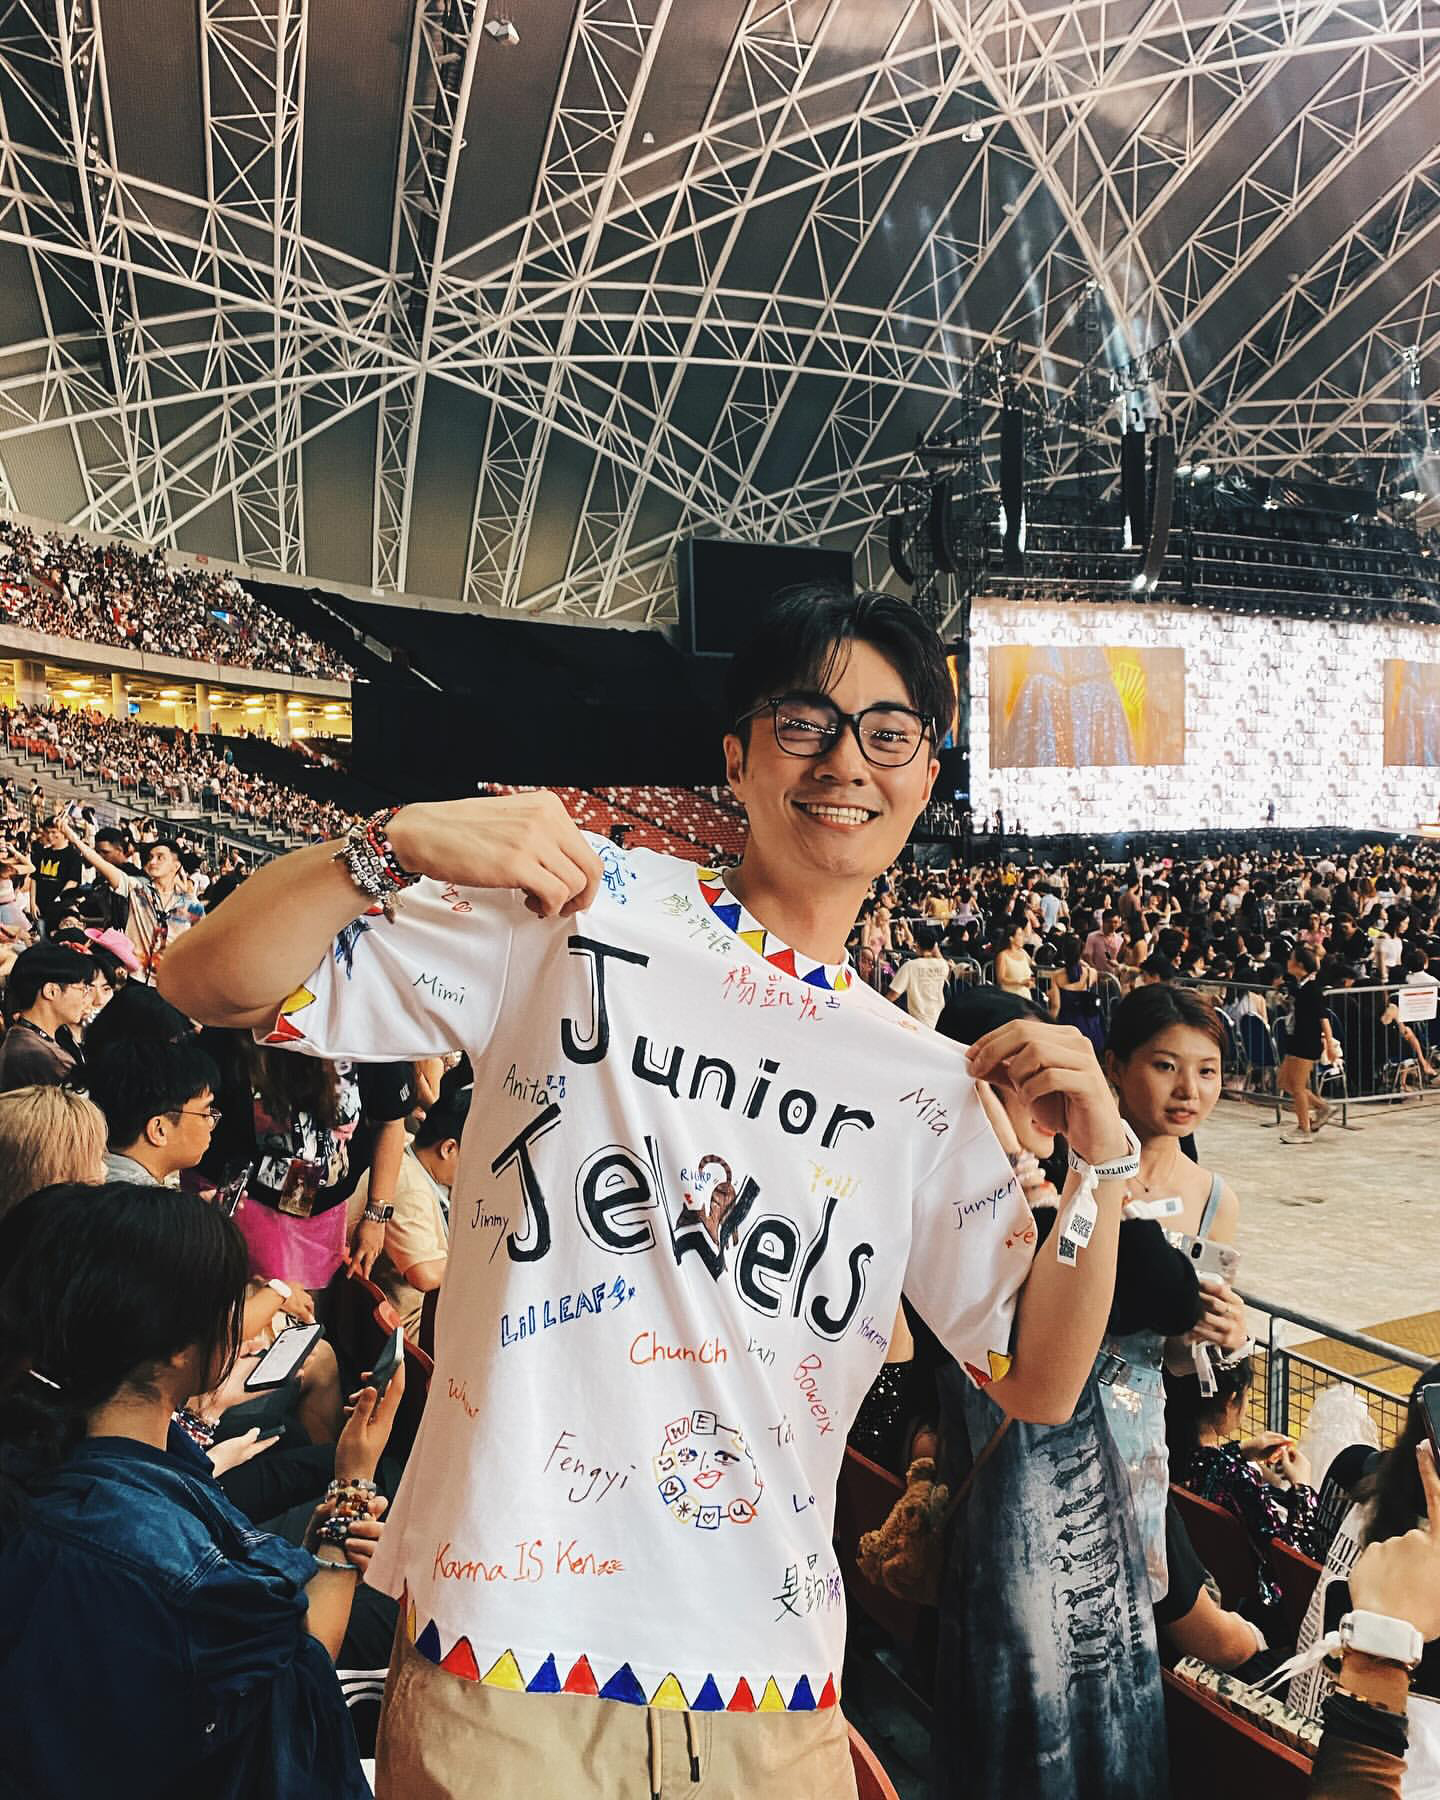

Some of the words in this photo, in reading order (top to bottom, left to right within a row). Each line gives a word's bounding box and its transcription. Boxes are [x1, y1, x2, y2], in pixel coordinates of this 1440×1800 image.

[412, 972, 465, 1006] Mimi
[561, 935, 875, 1149] Junior
[502, 1063, 550, 1105] Anita
[899, 1087, 949, 1136] Mita
[543, 1282, 606, 1329] LEAF
[543, 1430, 637, 1504] Fengyi
